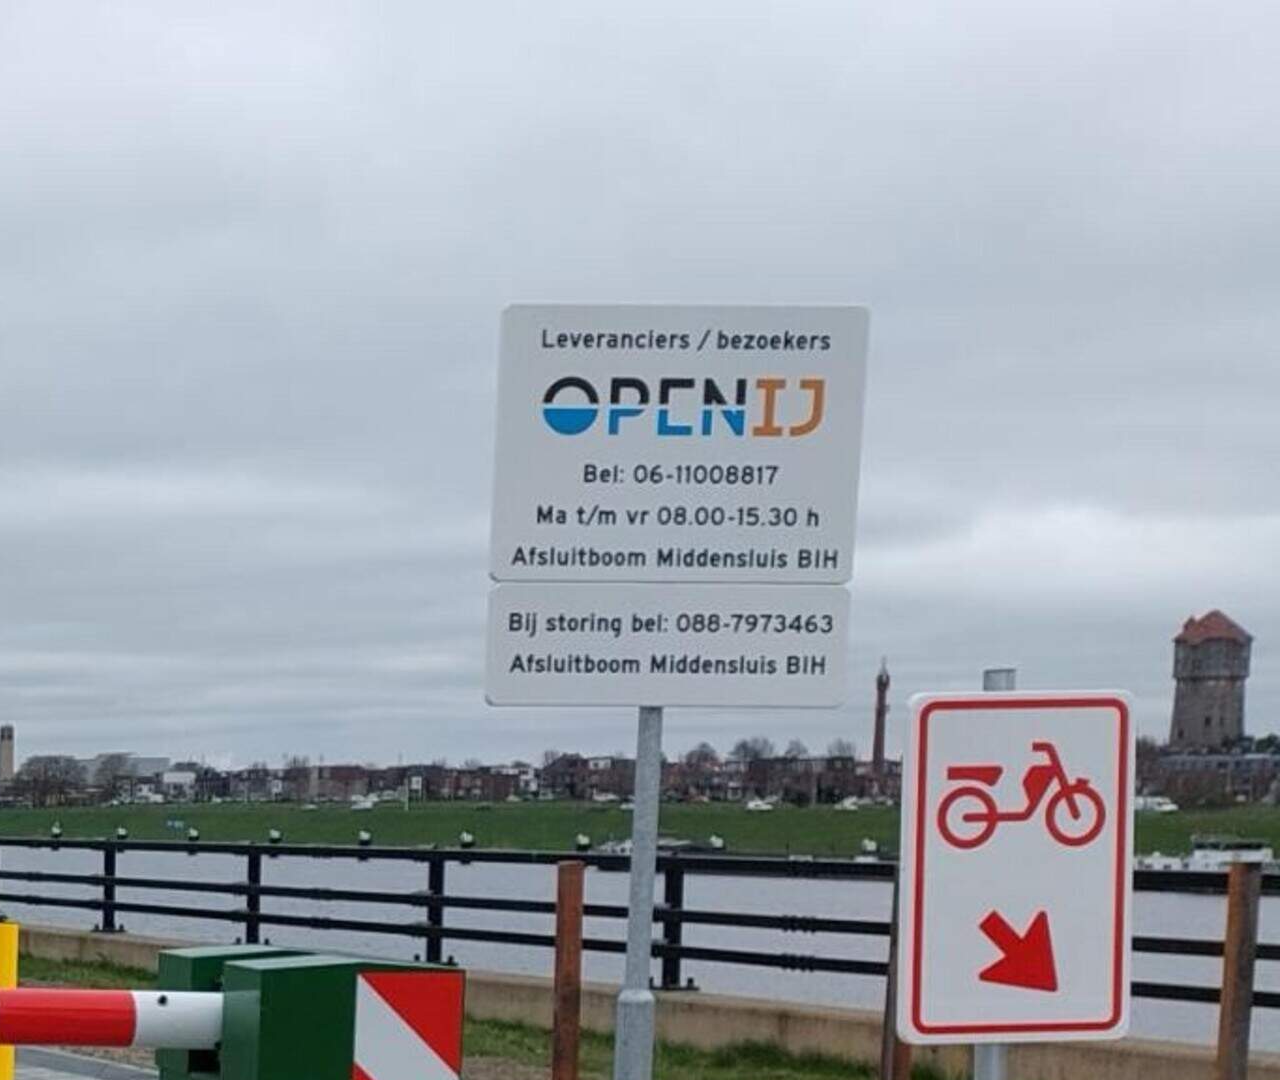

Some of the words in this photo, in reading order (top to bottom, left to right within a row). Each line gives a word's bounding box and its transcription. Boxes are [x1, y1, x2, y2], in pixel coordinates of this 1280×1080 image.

[541, 329, 691, 350] Leveranciers
[696, 329, 711, 352] /
[716, 330, 831, 351] bezoekers
[583, 463, 624, 484] Bel:
[633, 464, 779, 485] 06-11008817
[536, 505, 567, 525] Ma
[576, 504, 617, 526] t/m
[626, 509, 650, 525] vr
[657, 506, 798, 527] 08.00-15.30
[806, 508, 820, 527] h
[511, 546, 647, 567] Afsluitboom
[656, 547, 788, 569] Middensluis
[797, 548, 839, 569] BIH
[508, 612, 537, 638] Bij
[545, 613, 622, 639] storing
[631, 613, 669, 633] bel:
[676, 613, 833, 634] 088-7973463
[509, 653, 641, 674] Afsluitboom
[649, 654, 777, 675] Middensluis
[786, 655, 826, 675] BIH
